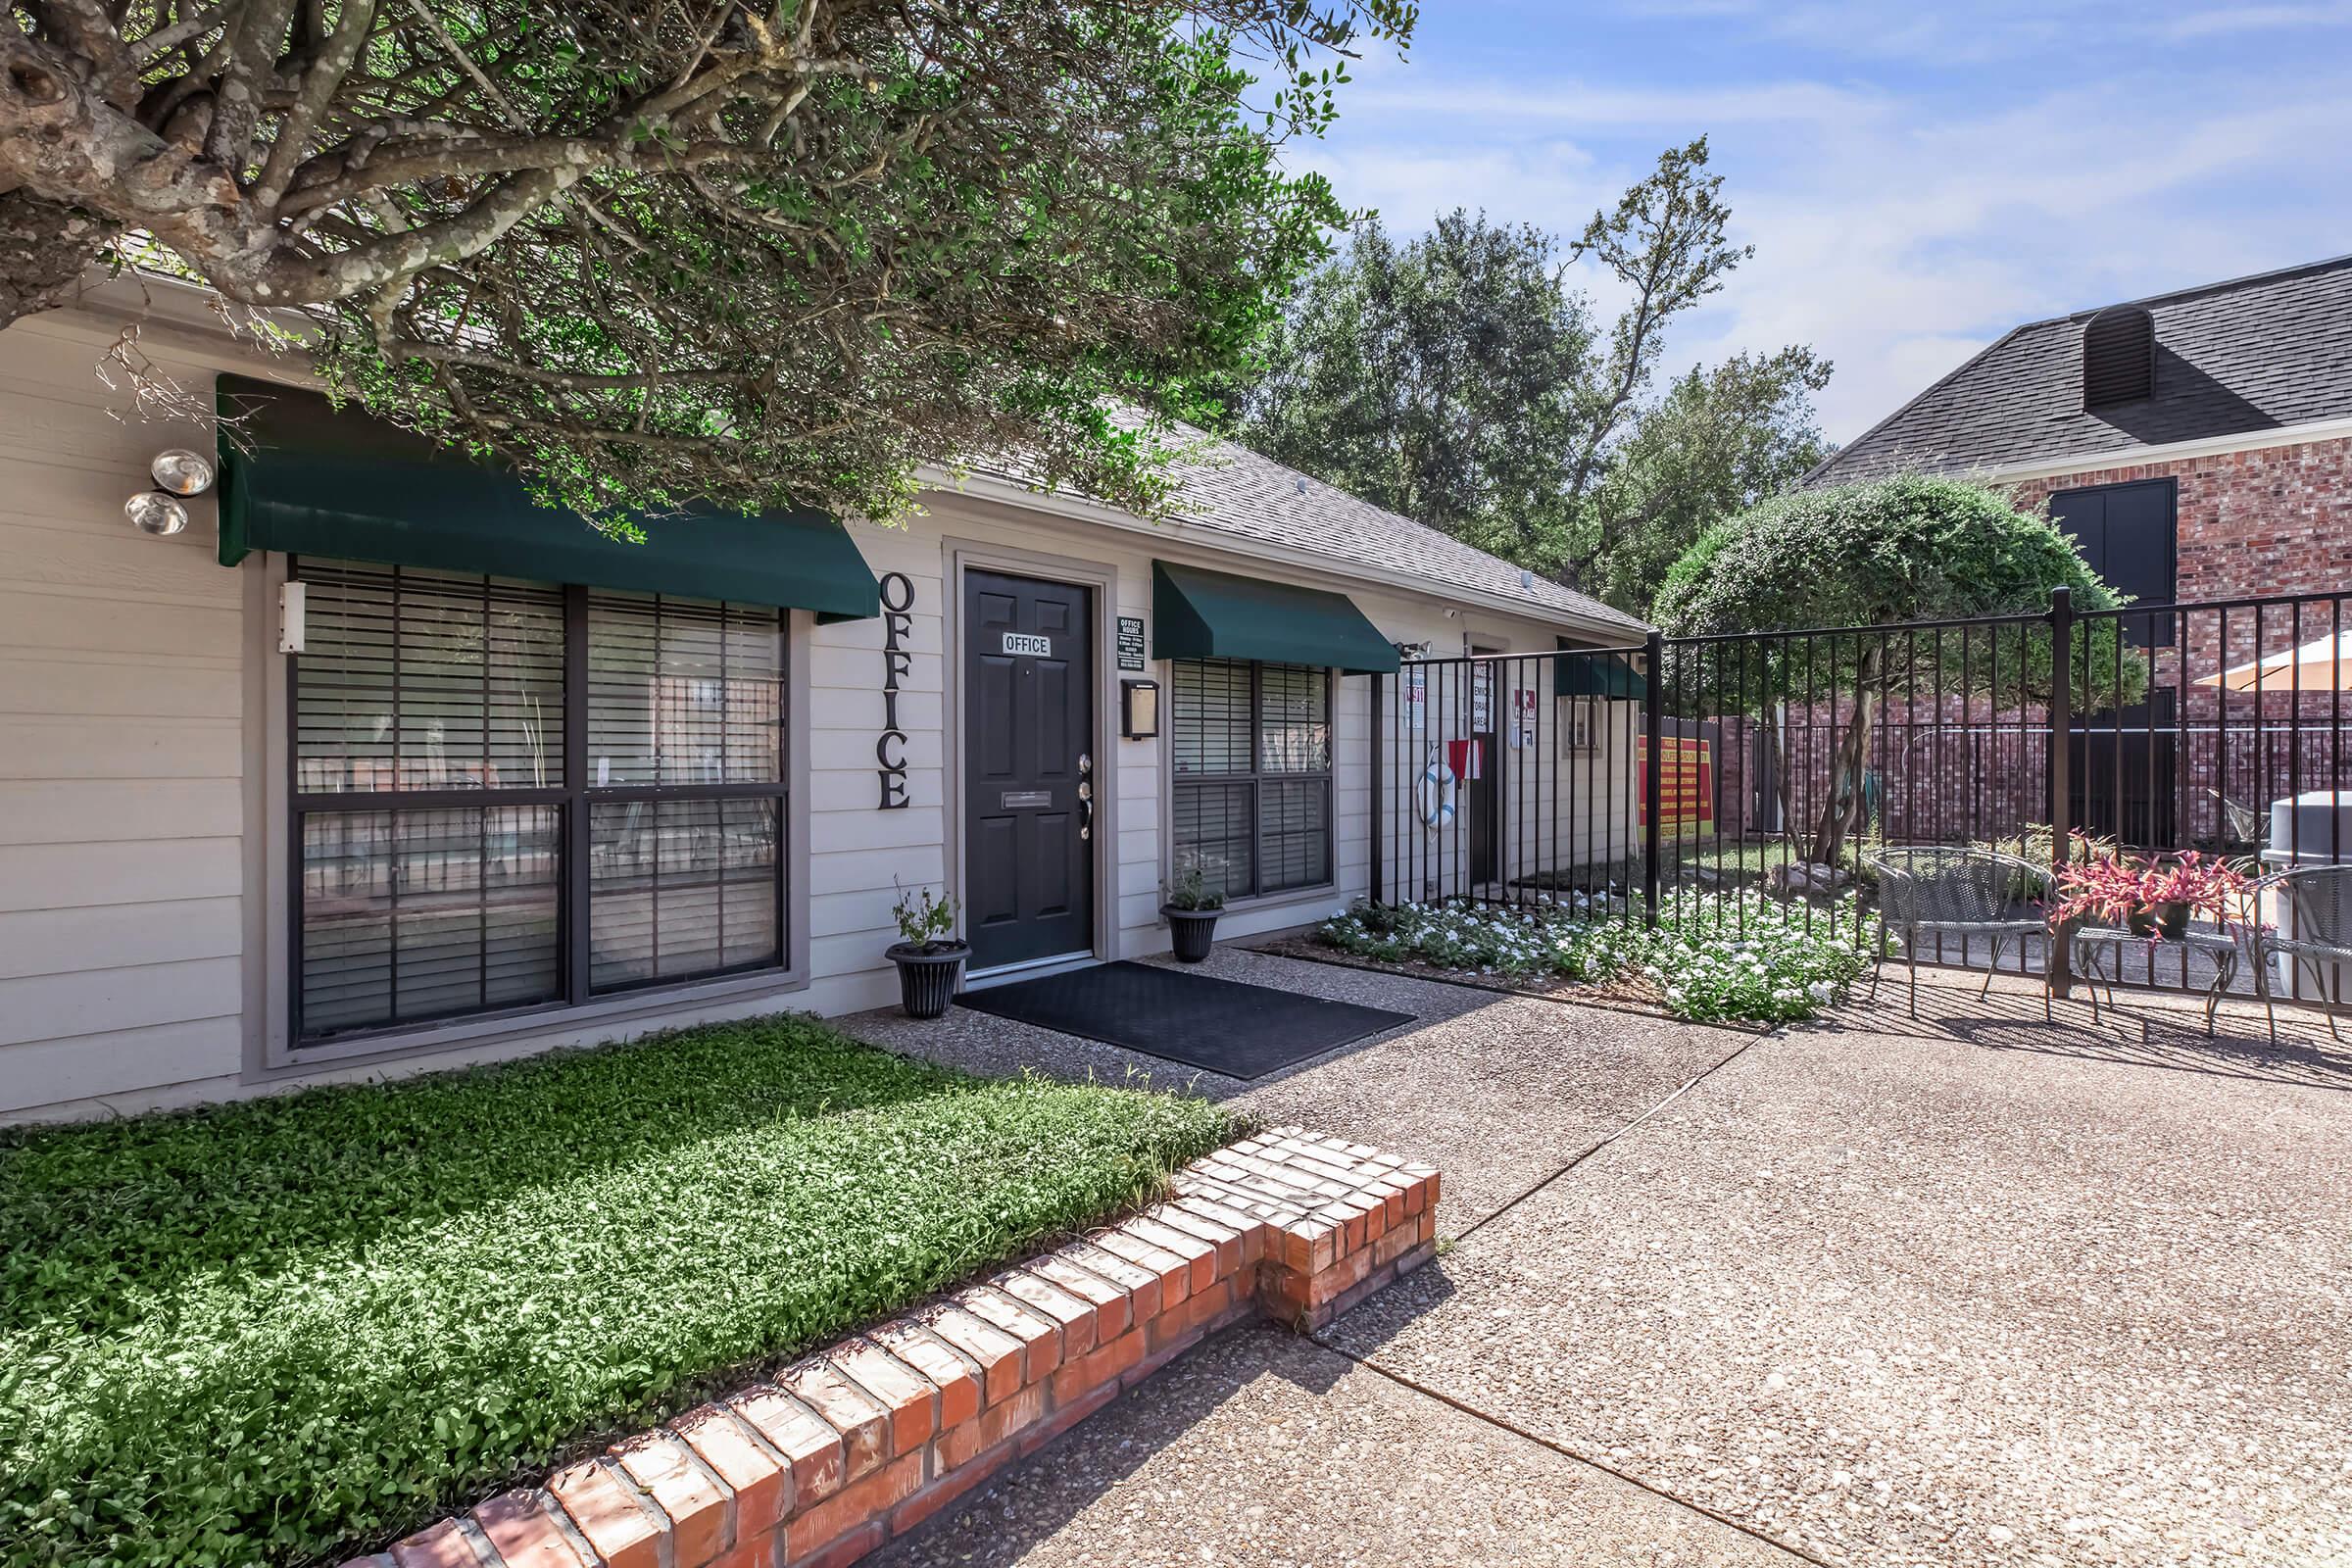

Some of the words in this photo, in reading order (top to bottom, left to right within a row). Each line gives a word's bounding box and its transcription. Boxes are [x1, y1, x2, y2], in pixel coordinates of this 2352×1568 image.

[1120, 619, 1141, 628] OFFICE
[1006, 635, 1048, 653] OFFICE
[876, 571, 915, 810] OFFICE
